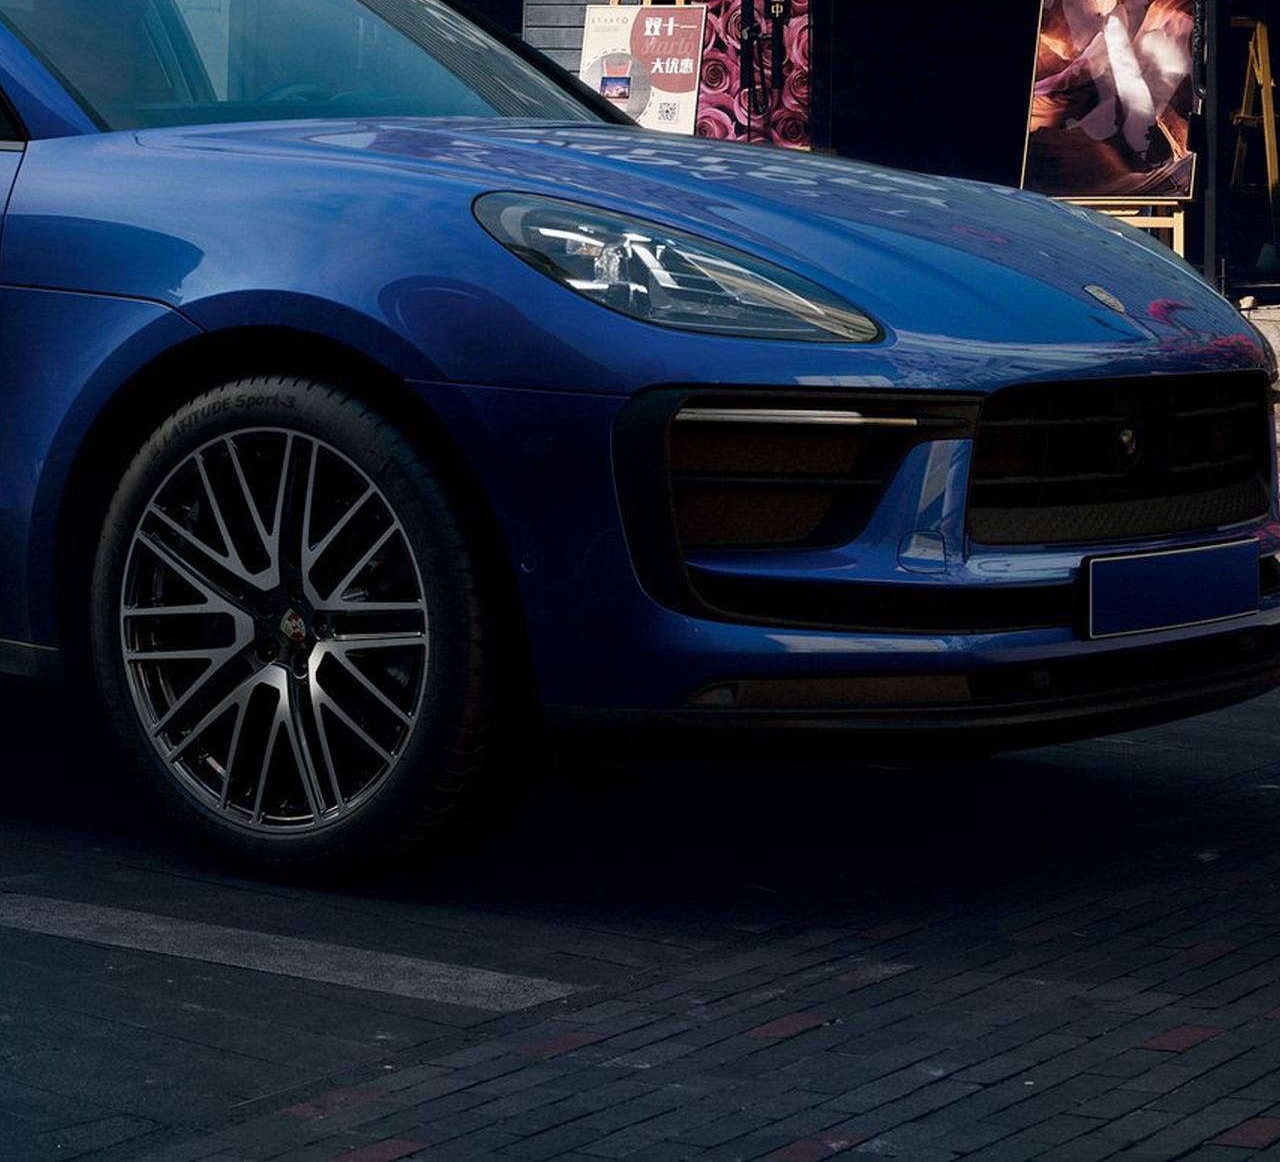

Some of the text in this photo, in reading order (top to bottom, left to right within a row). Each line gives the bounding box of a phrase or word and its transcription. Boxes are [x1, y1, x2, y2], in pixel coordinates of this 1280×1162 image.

[643, 16, 698, 36] 双十一
[650, 57, 695, 75] 大优惠
[234, 393, 279, 411] Sport
